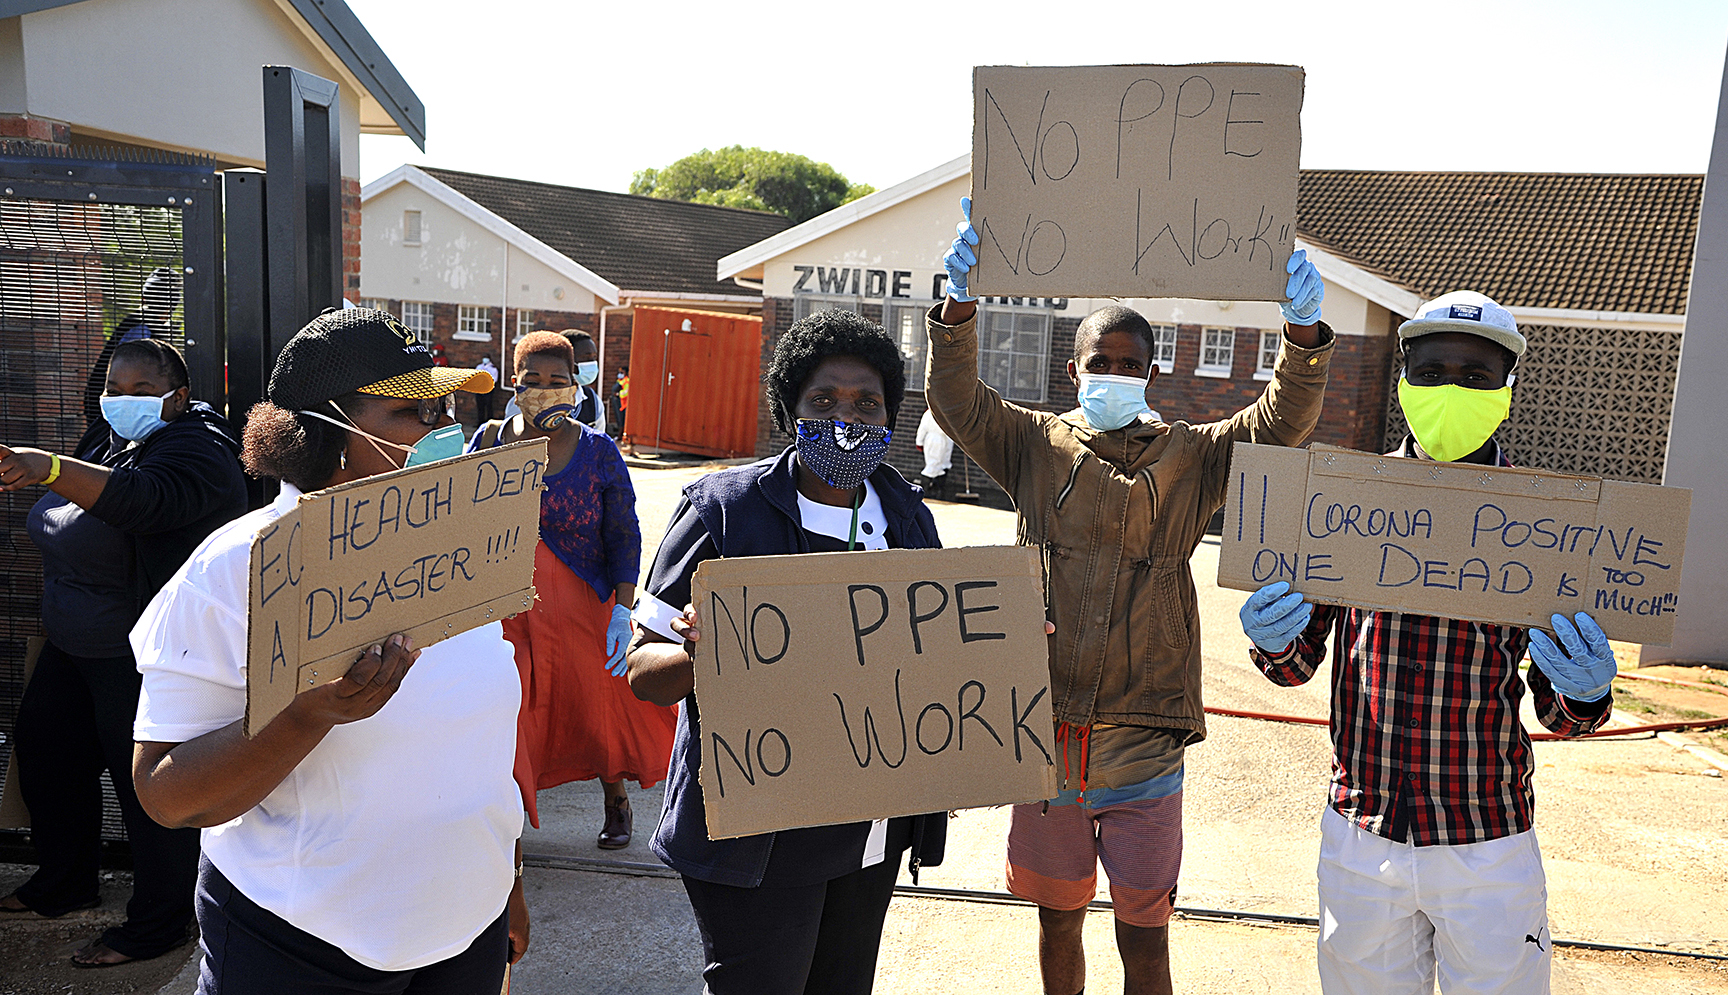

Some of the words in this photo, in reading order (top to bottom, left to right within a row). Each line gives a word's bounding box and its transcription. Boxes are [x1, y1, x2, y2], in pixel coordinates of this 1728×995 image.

[1113, 75, 1264, 181] PPE
[793, 265, 911, 299] ZWIDE
[328, 477, 453, 560] HEALTH
[1306, 492, 1433, 539] CORONA
[1471, 503, 1671, 570] POSITIVE
[1252, 548, 1344, 583] ONE
[1376, 542, 1533, 594] DEAD
[1602, 566, 1645, 587] TOO
[269, 620, 286, 684] A
[847, 580, 1007, 666] PPE
[832, 668, 1054, 769] WORK
